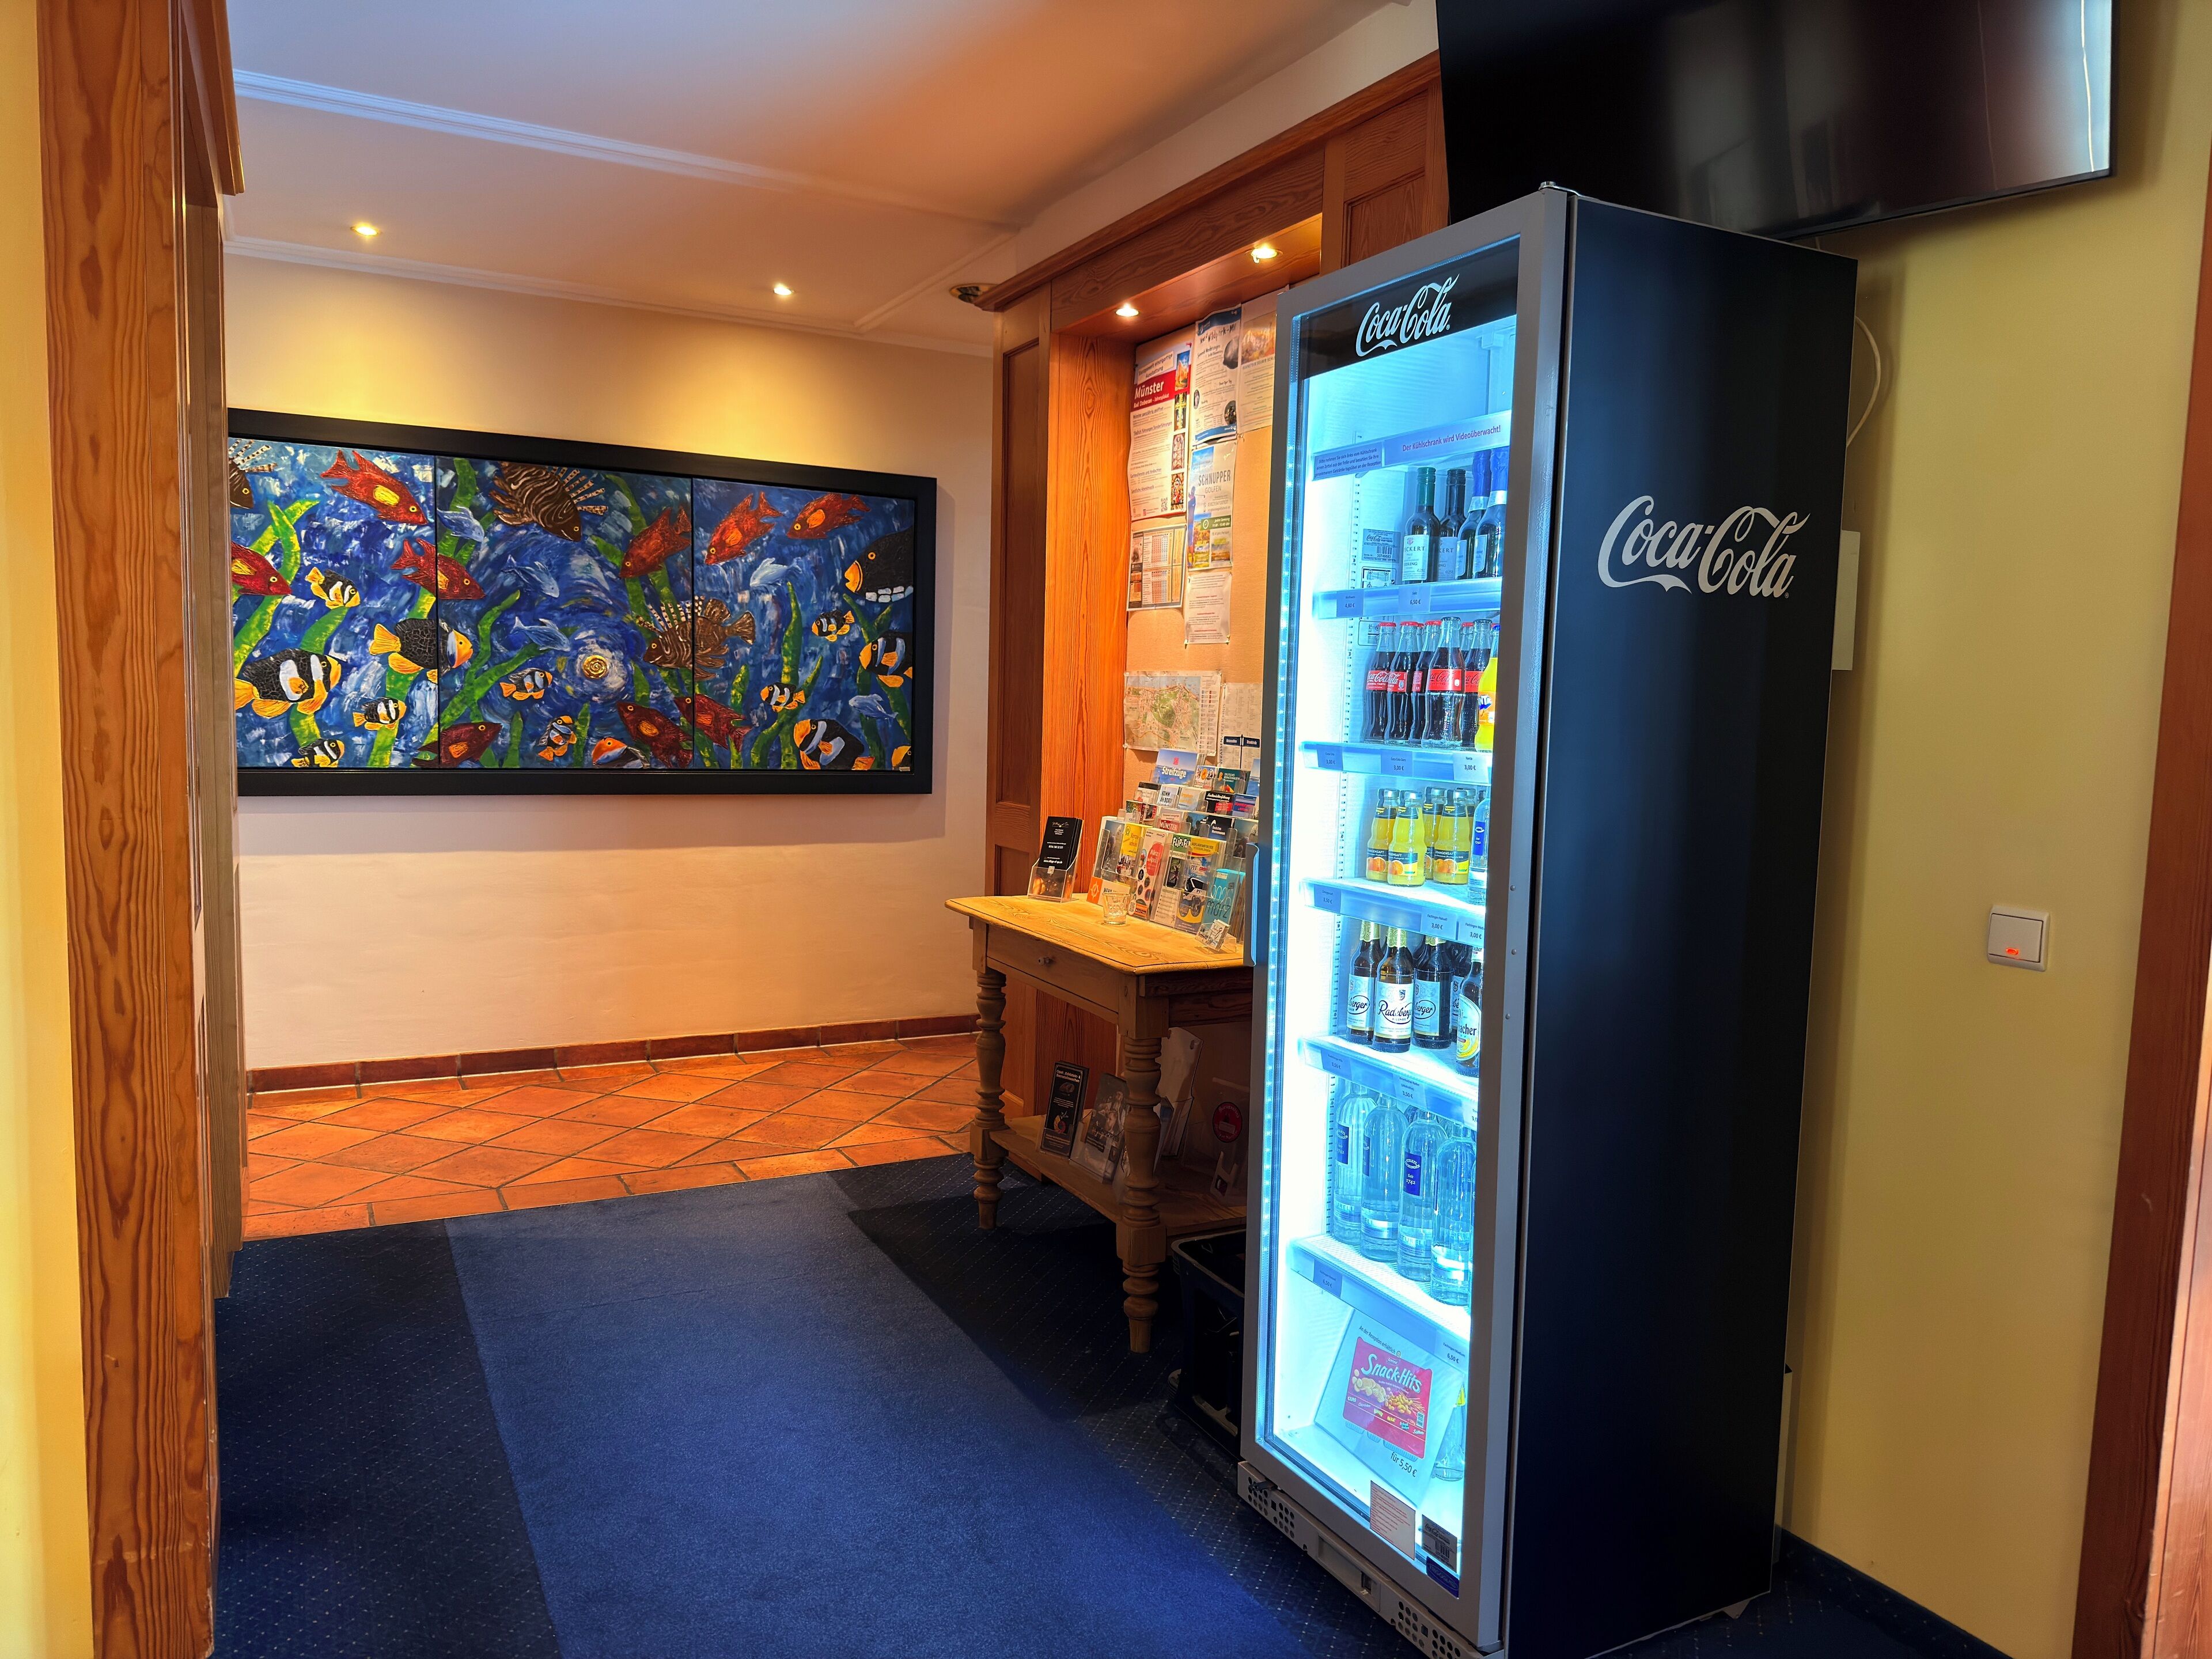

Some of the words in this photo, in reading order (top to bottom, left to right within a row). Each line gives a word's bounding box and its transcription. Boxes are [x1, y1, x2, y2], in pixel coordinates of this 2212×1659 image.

[1356, 274, 1460, 357] Coca-Cola
[1135, 381, 1164, 400] Münster
[1403, 444, 1411, 452] Der
[1412, 437, 1442, 450] Kühlschrank
[1443, 434, 1455, 444] wird
[1456, 425, 1501, 441] Videoüberwacht!
[1199, 470, 1231, 486] SCHNUPPER
[1205, 485, 1222, 494] GOLFEN
[1597, 495, 1810, 598] Coca-Cola
[1162, 766, 1187, 779] Streifzüge
[1160, 820, 1177, 831] MÜNSTER
[1369, 1332, 1381, 1344] Rezeption
[1381, 1342, 1396, 1354] erhältlich
[1447, 1353, 1456, 1361] 6,50
[1361, 1353, 1422, 1393] Snack-Hits
[1391, 1452, 1399, 1463] für
[1399, 1459, 1412, 1473] 5,50
[1412, 1469, 1417, 1477] €
